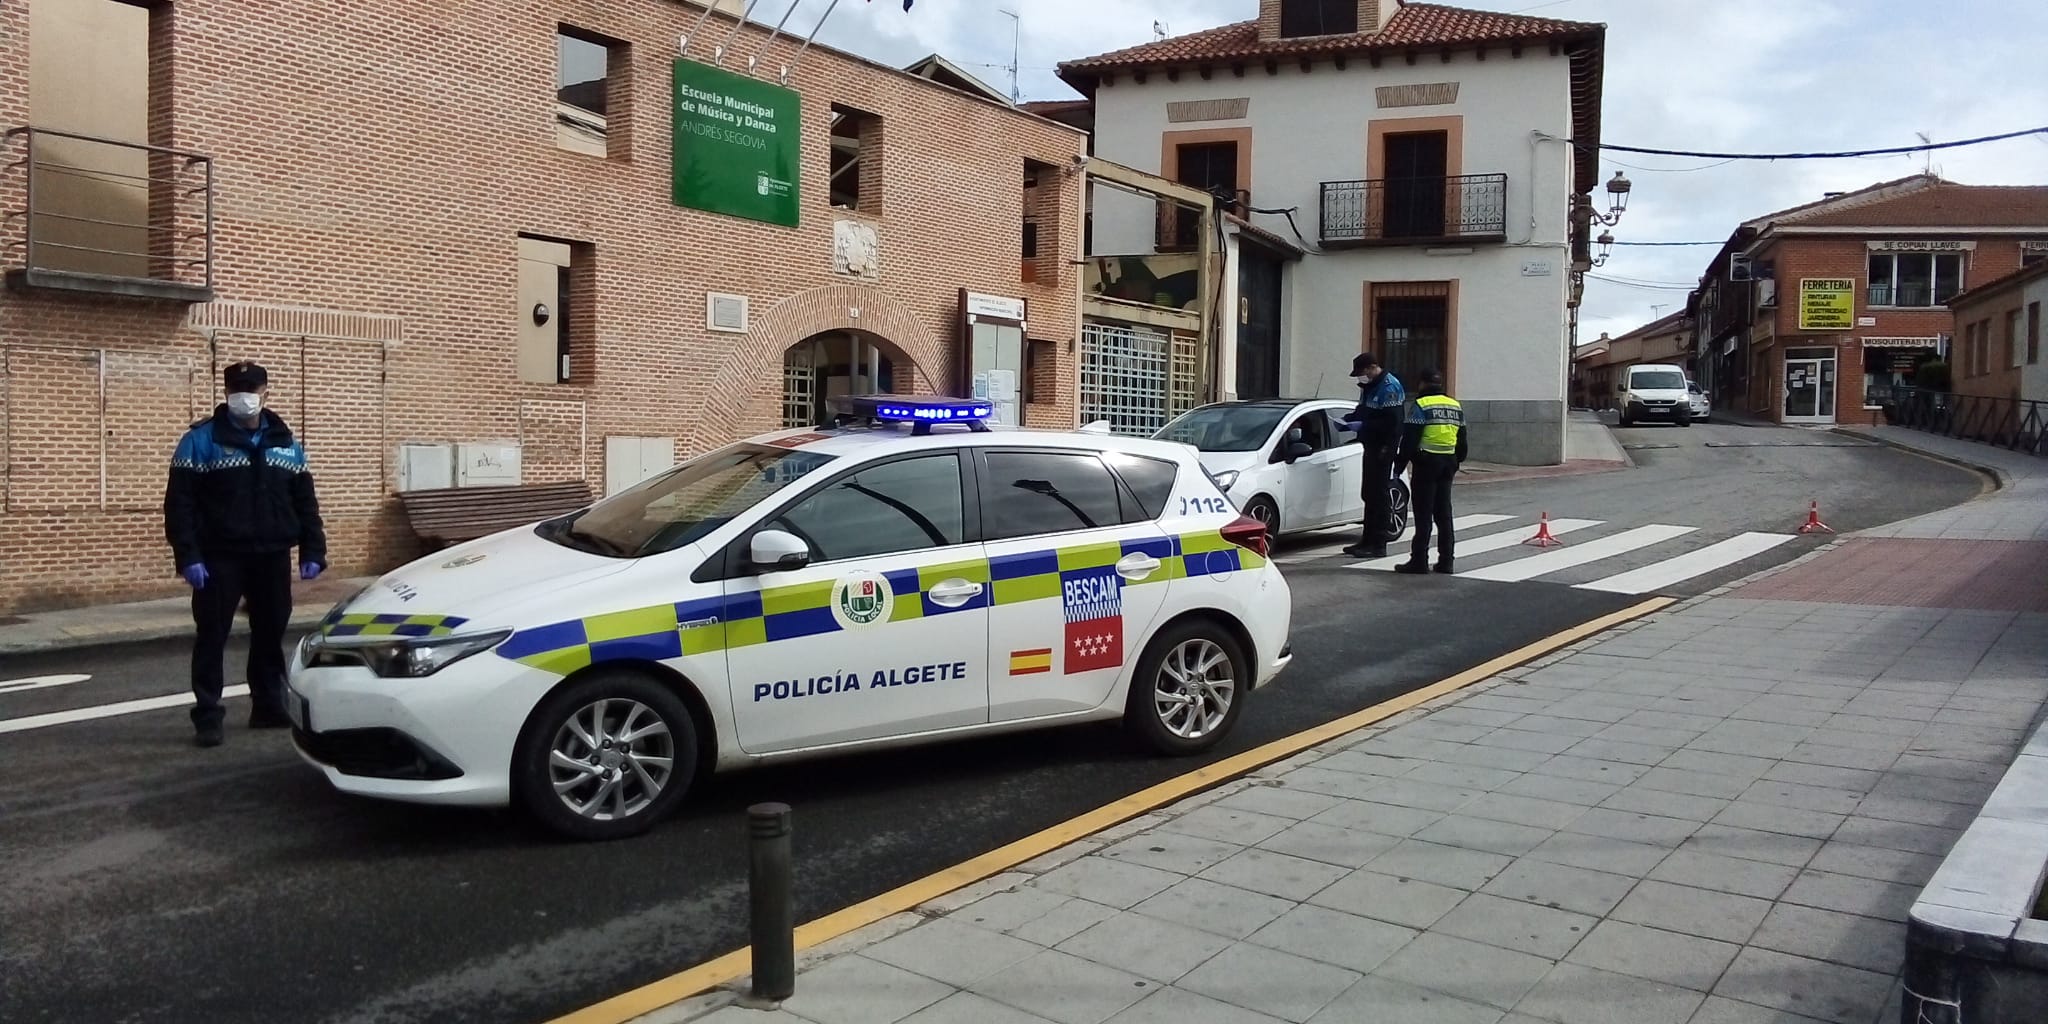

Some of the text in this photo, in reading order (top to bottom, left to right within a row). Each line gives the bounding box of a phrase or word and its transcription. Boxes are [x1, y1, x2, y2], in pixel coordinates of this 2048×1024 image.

[681, 84, 774, 119] Escuela Municipal
[681, 100, 776, 133] de Música y Danza
[681, 120, 767, 150] ANDRÉS SEGOVIA
[1884, 241, 1961, 249] SE COPIAN LLAVES
[1802, 280, 1853, 290] FERRETERIA
[1864, 338, 1921, 346] MOSQUITERAS
[1432, 408, 1460, 421] POLICIA
[1190, 497, 1228, 514] 112
[1064, 574, 1118, 607] BESCAM
[842, 600, 883, 623] POLICIA LOCAL
[753, 661, 967, 702] POLICÍA ALGETE
